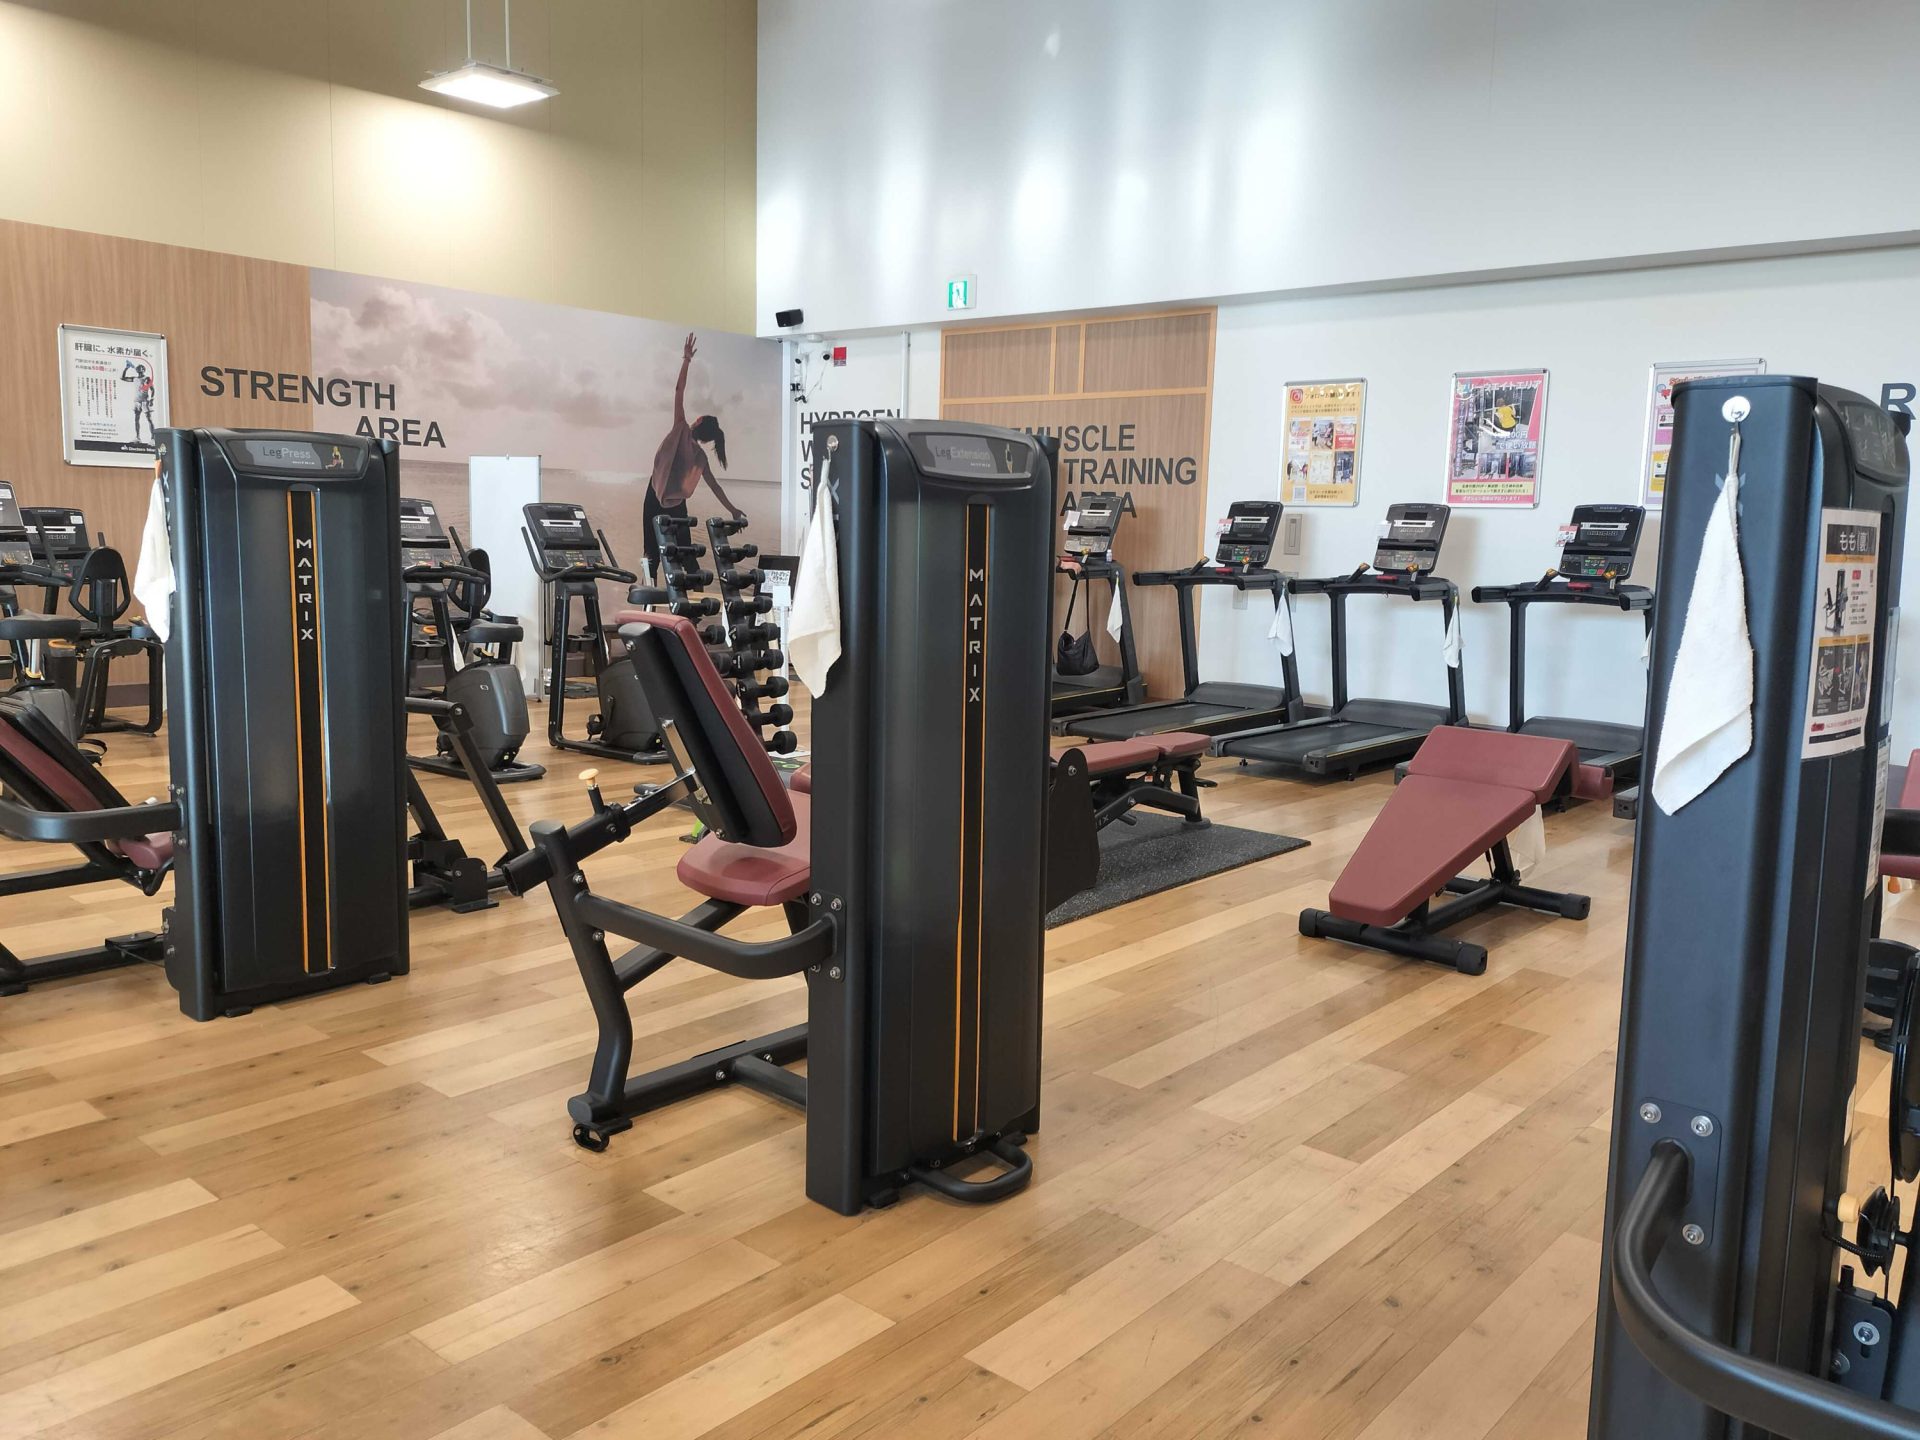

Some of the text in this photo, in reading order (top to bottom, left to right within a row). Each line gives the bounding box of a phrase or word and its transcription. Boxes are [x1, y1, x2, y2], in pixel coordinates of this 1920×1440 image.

[200, 366, 396, 410] STRENGTH
[356, 416, 447, 448] AREA
[1064, 457, 1197, 486] TRAINING
[296, 538, 314, 641] MATRIX
[969, 568, 984, 703] MATRIX
